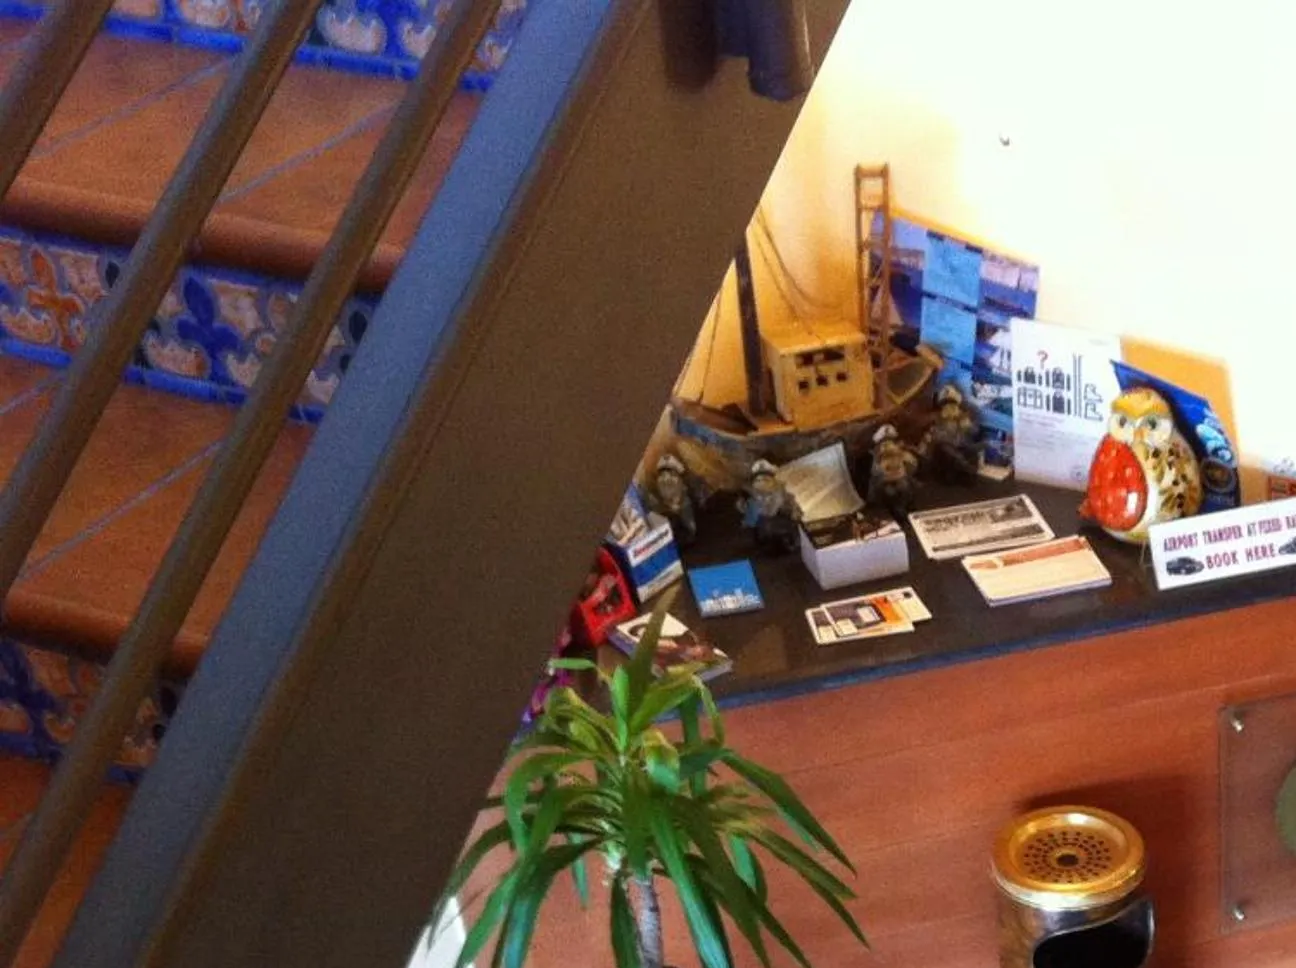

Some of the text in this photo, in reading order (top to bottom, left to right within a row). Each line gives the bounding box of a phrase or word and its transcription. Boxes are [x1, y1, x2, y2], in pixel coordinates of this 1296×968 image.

[1163, 532, 1198, 552] AIRPORT
[1203, 525, 1243, 545] TRANSFER
[1247, 522, 1257, 537] AT
[1206, 542, 1275, 570] BOOK HERE
